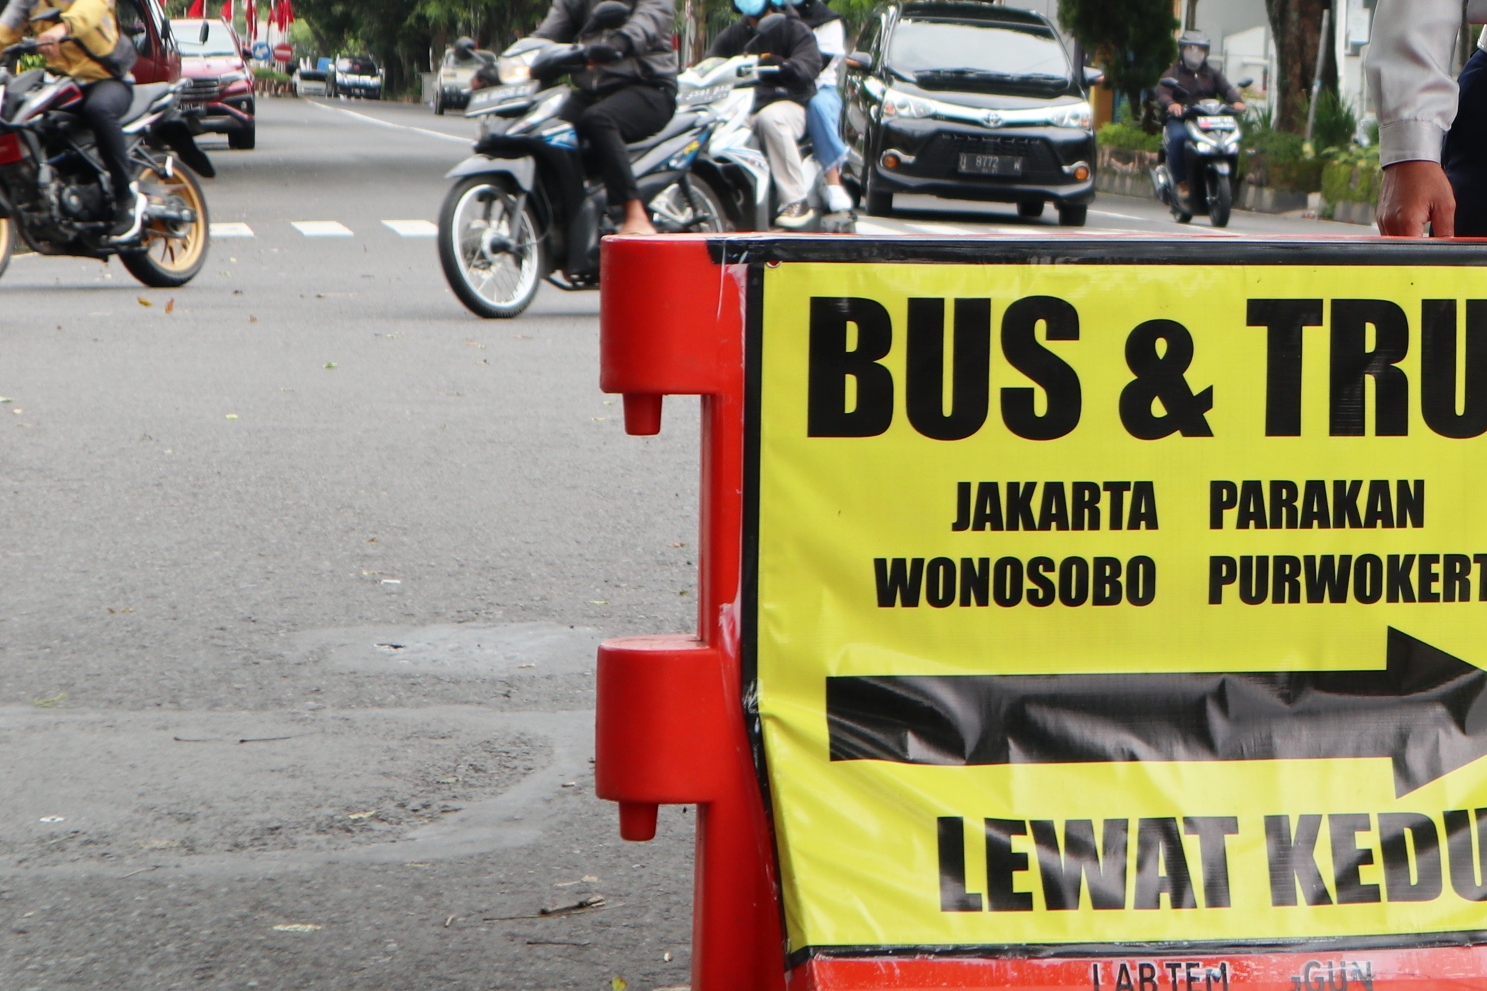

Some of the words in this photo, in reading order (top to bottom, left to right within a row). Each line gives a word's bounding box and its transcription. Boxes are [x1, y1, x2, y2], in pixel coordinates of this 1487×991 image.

[807, 295, 1082, 442] BUS
[1119, 318, 1215, 441] &
[951, 480, 1159, 532] JAKARTA
[1209, 479, 1425, 530] PARAKAN
[873, 555, 1157, 609] WONOSOBO
[936, 816, 1238, 912] LEWAT
